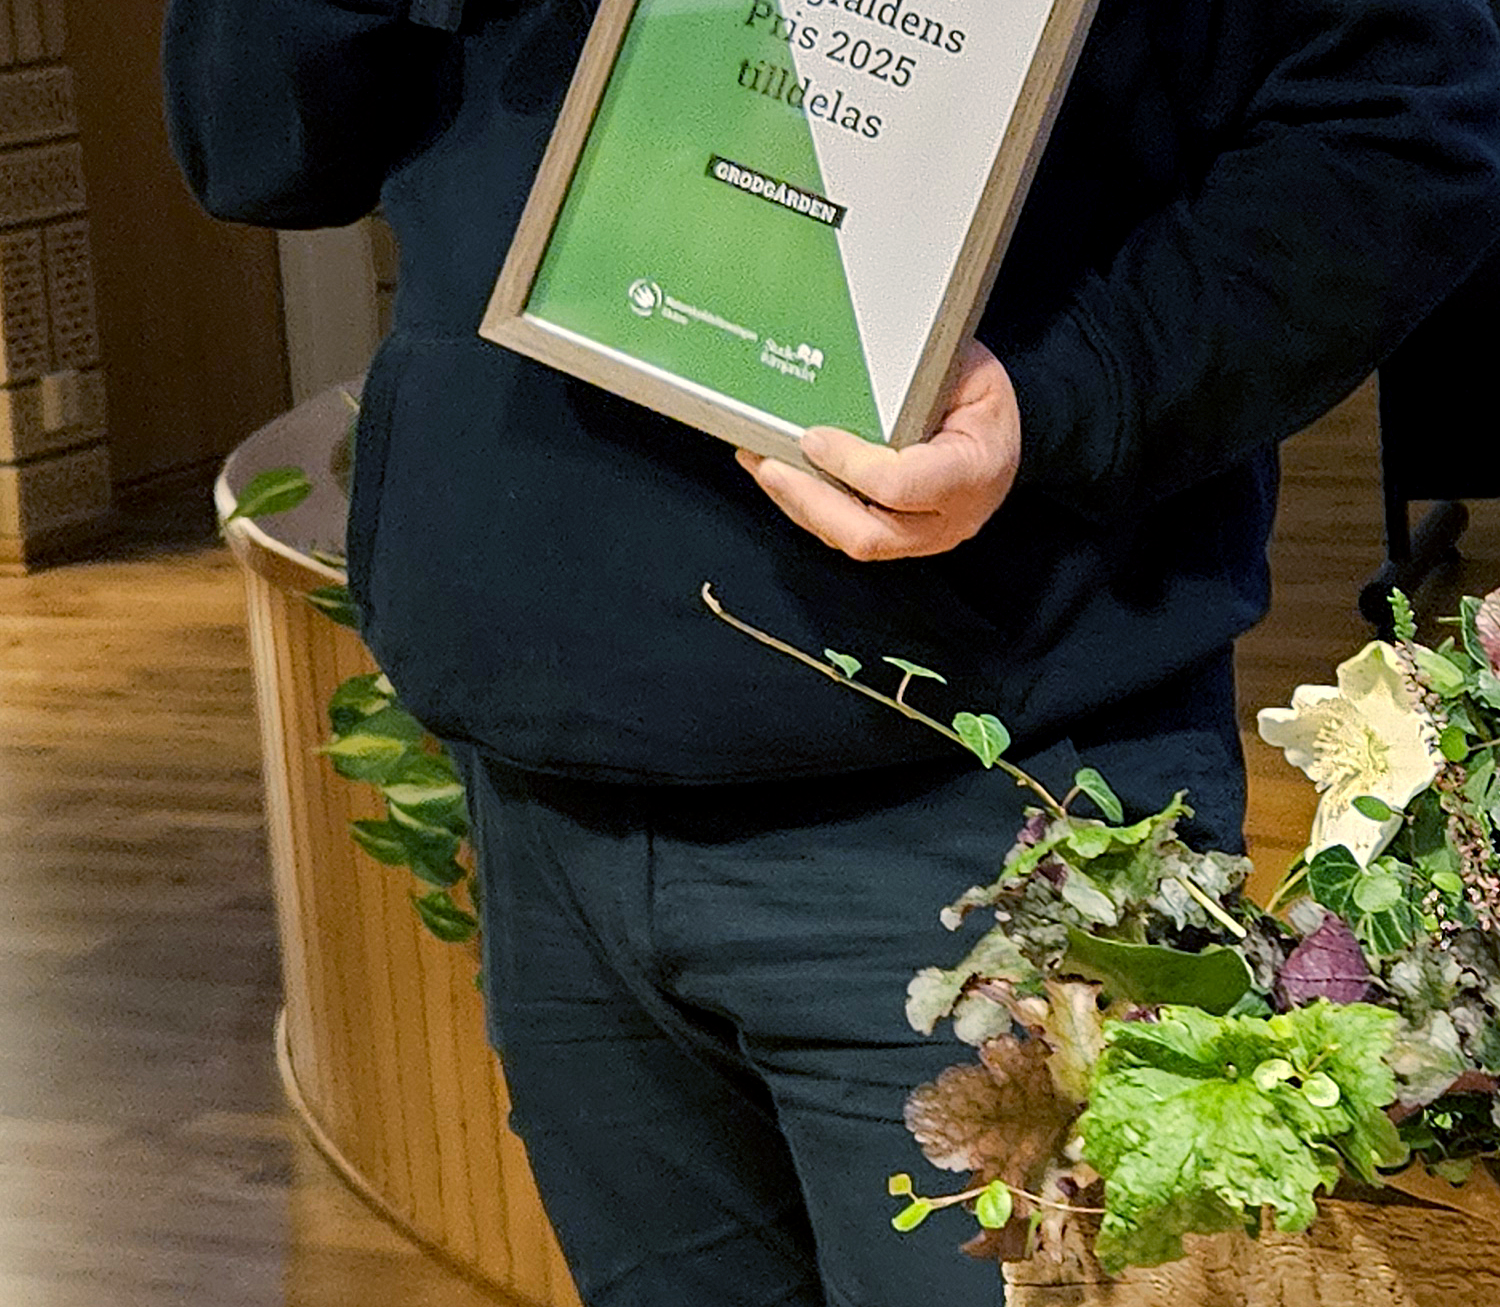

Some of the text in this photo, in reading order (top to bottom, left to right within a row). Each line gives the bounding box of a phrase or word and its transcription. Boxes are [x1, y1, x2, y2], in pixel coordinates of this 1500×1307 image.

[826, 30, 917, 87] 2025
[737, 58, 883, 139] tilldelas
[714, 161, 837, 224] GRODGÅRDEN
